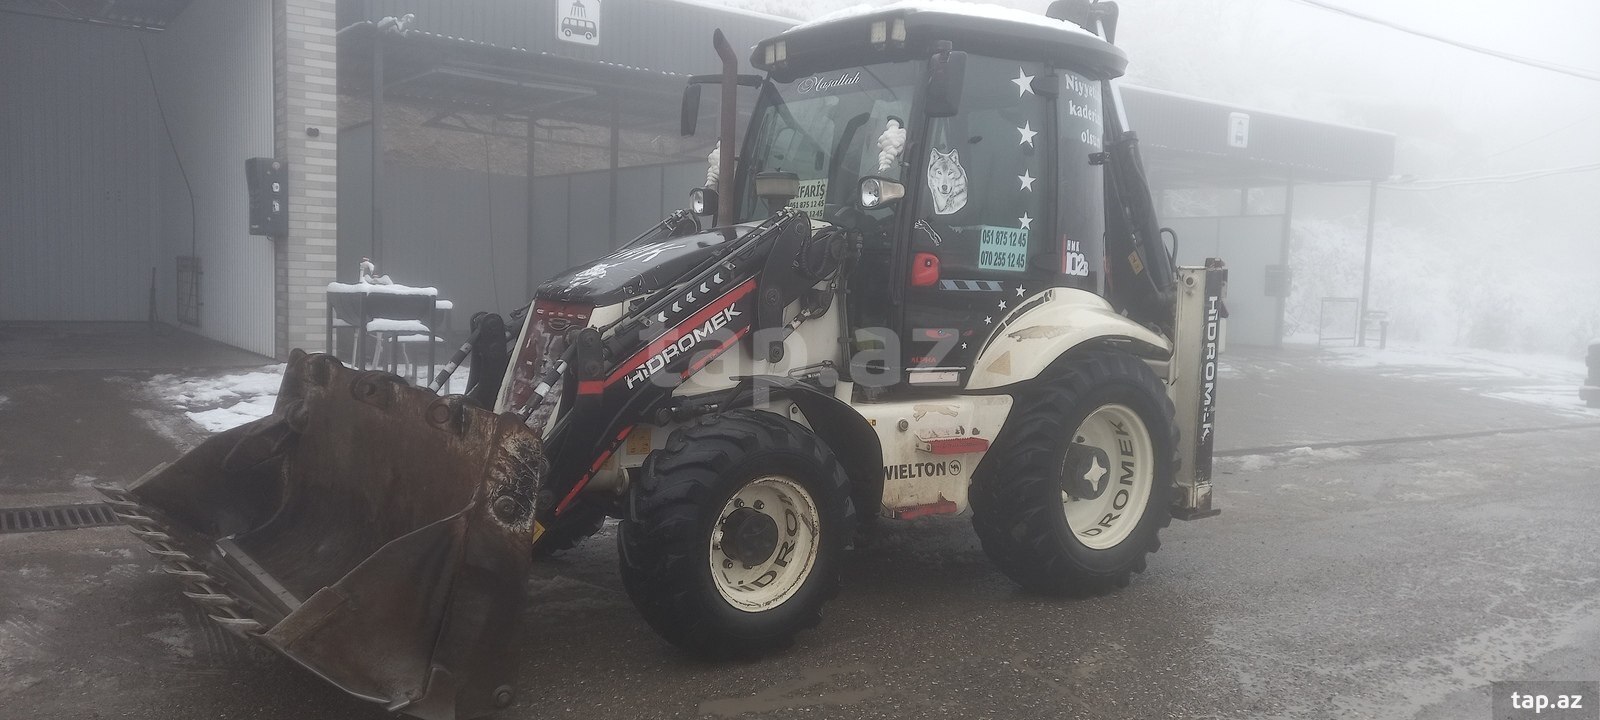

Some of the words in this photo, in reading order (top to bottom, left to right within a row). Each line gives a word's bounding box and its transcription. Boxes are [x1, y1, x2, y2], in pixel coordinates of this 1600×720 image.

[810, 200, 817, 208] 12
[817, 199, 825, 207] 45
[982, 229, 994, 245] 051
[995, 230, 1008, 246] 875
[1009, 232, 1017, 247] 12
[1018, 232, 1027, 247] 45
[980, 250, 993, 266] 070
[993, 251, 1006, 267] 255
[1007, 252, 1016, 267] 12
[1016, 253, 1025, 268] 45
